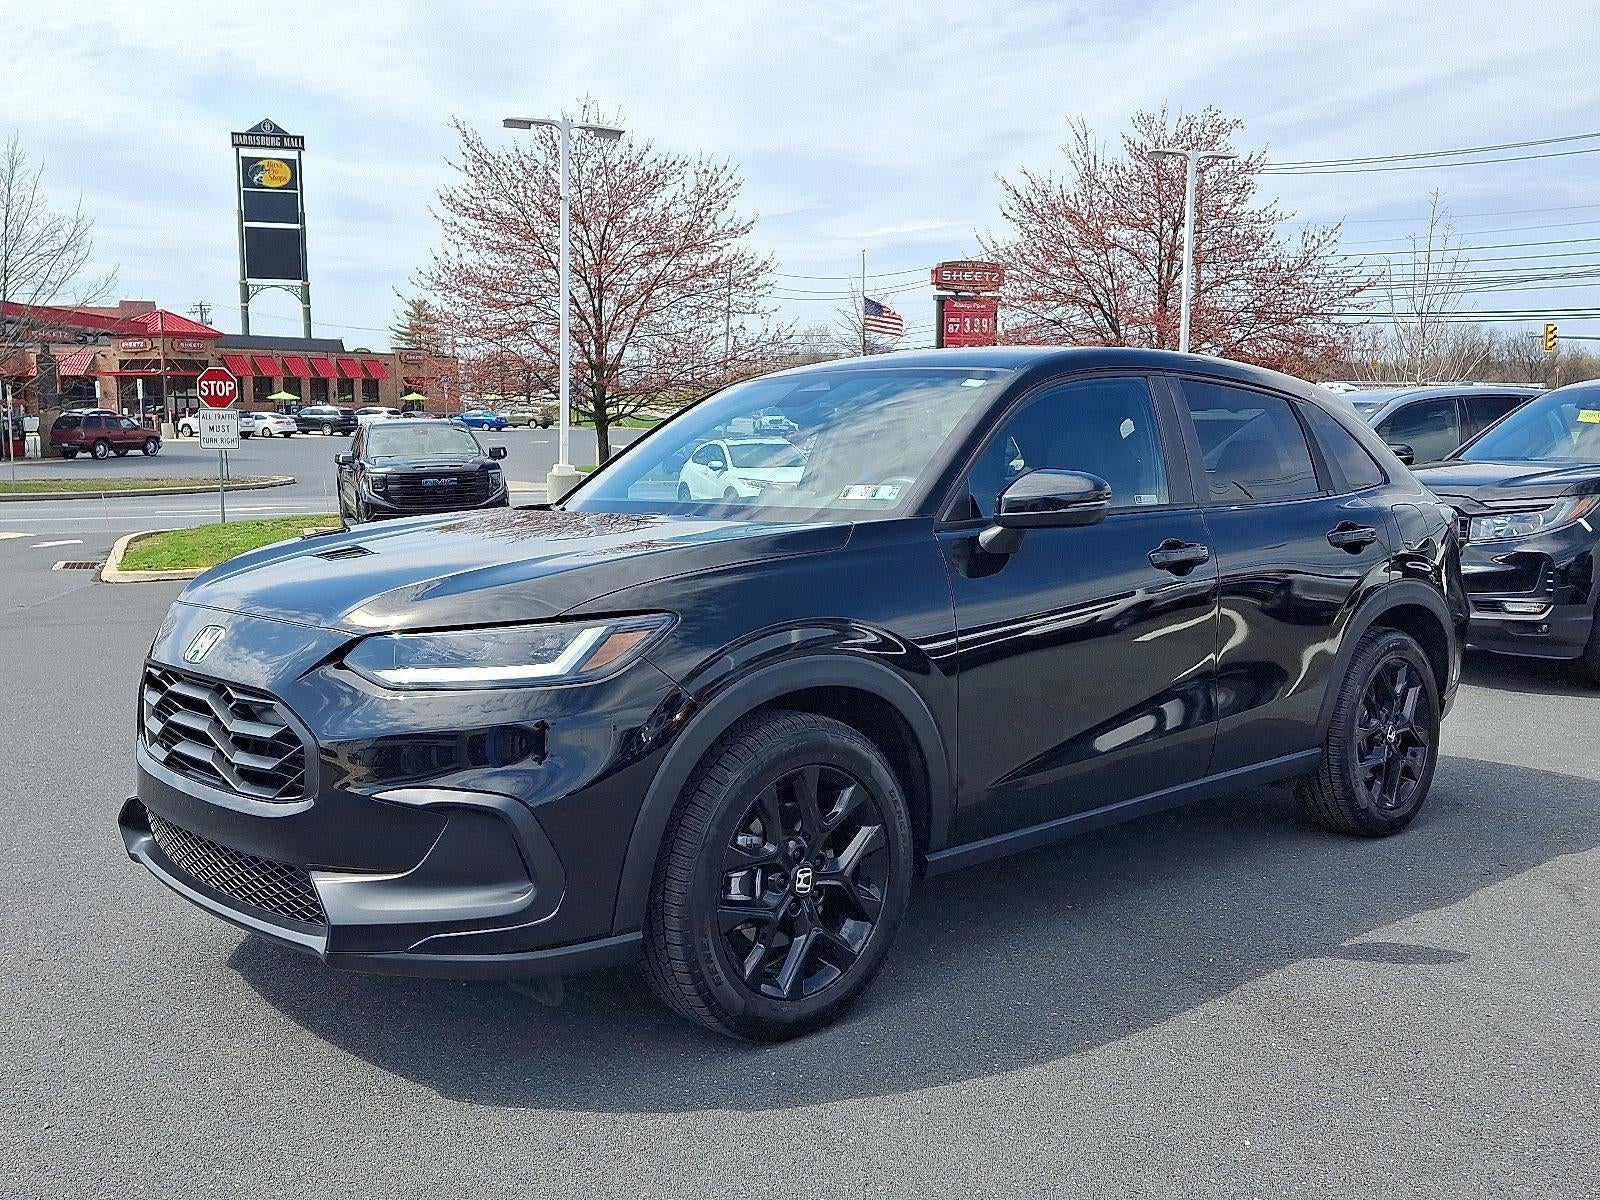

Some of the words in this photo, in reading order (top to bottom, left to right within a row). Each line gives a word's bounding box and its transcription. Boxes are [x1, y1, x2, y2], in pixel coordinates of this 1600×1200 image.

[232, 134, 281, 147] HARRISBURG
[283, 137, 303, 148] MALL
[266, 161, 283, 169] Bass
[942, 270, 1000, 282] SHEETZ
[947, 323, 960, 333] 87
[200, 380, 235, 397] STOP
[214, 413, 236, 421] TRAFFIC
[208, 424, 230, 433] MUST
[421, 477, 458, 486] GMC
